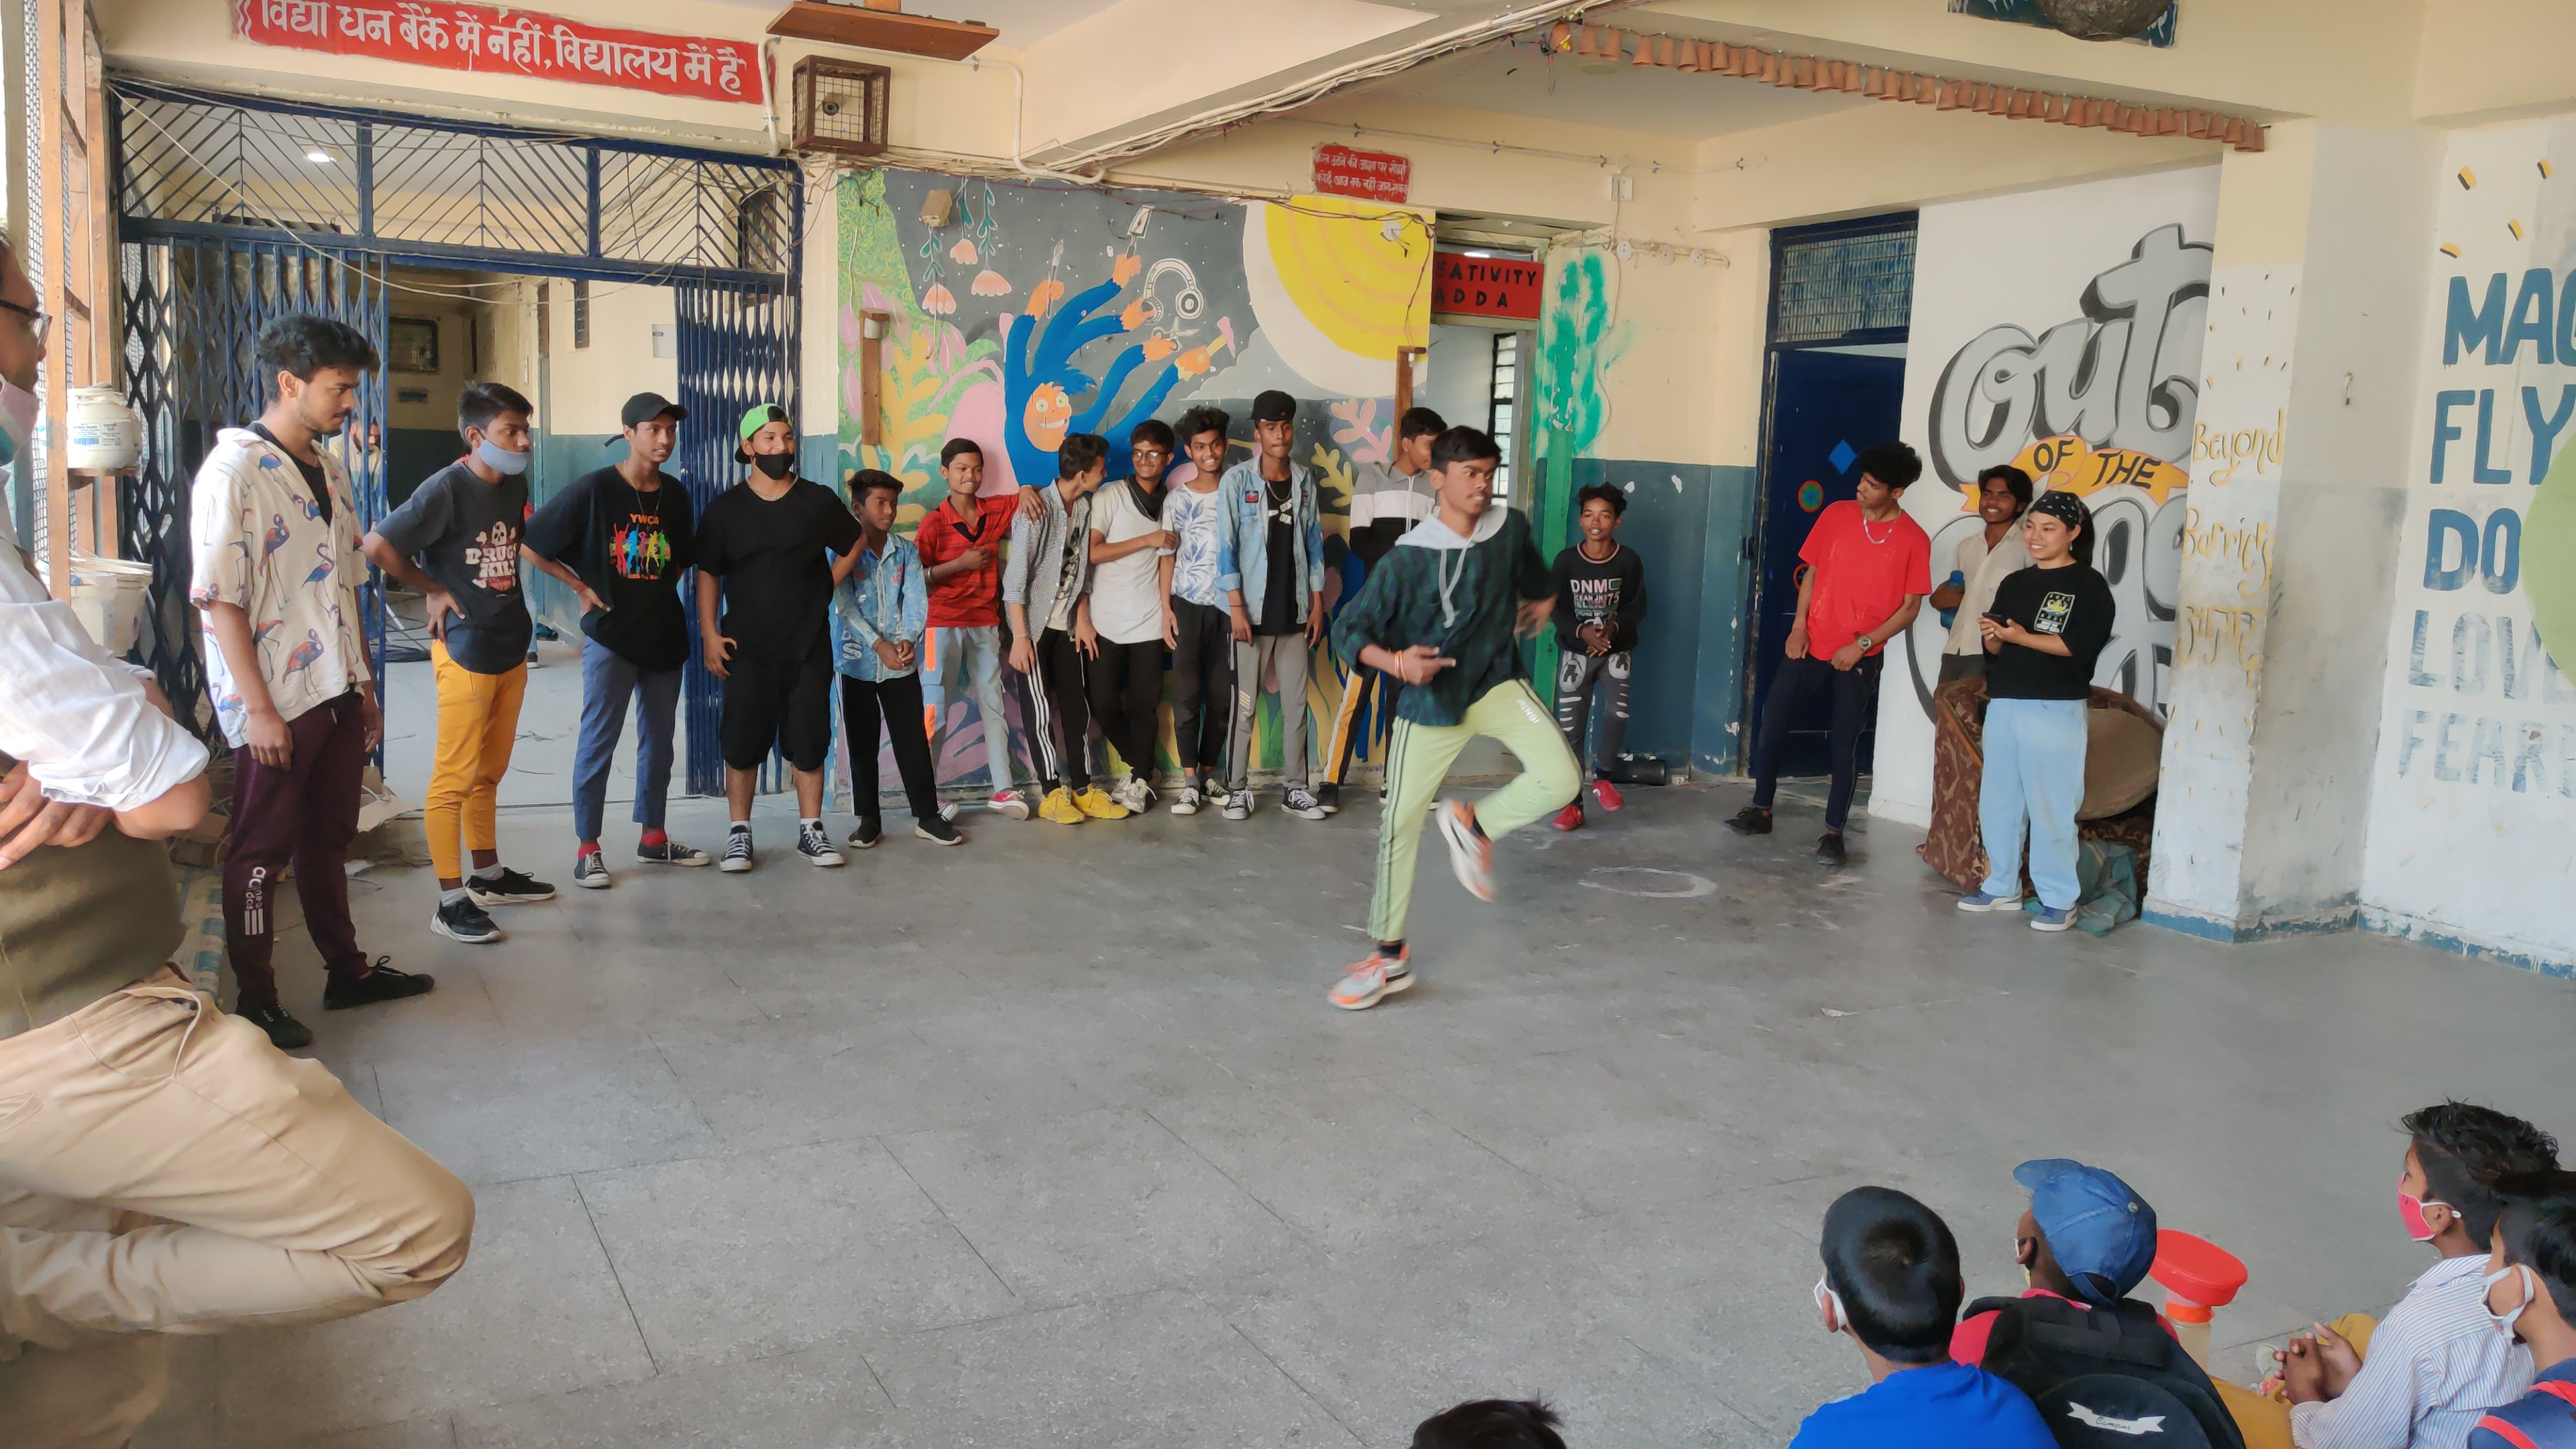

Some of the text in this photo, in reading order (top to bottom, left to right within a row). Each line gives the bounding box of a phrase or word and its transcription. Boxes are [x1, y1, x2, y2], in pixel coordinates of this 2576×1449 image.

[335, 5, 396, 46] धन
[455, 9, 486, 56] में
[682, 42, 715, 87] में
[715, 46, 747, 96] है
[1434, 286, 1508, 308] ADDA
[2033, 438, 2161, 490] OF THE
[2191, 407, 2286, 486] Beyond
[630, 513, 659, 525] YWCA
[2423, 508, 2522, 594] DO
